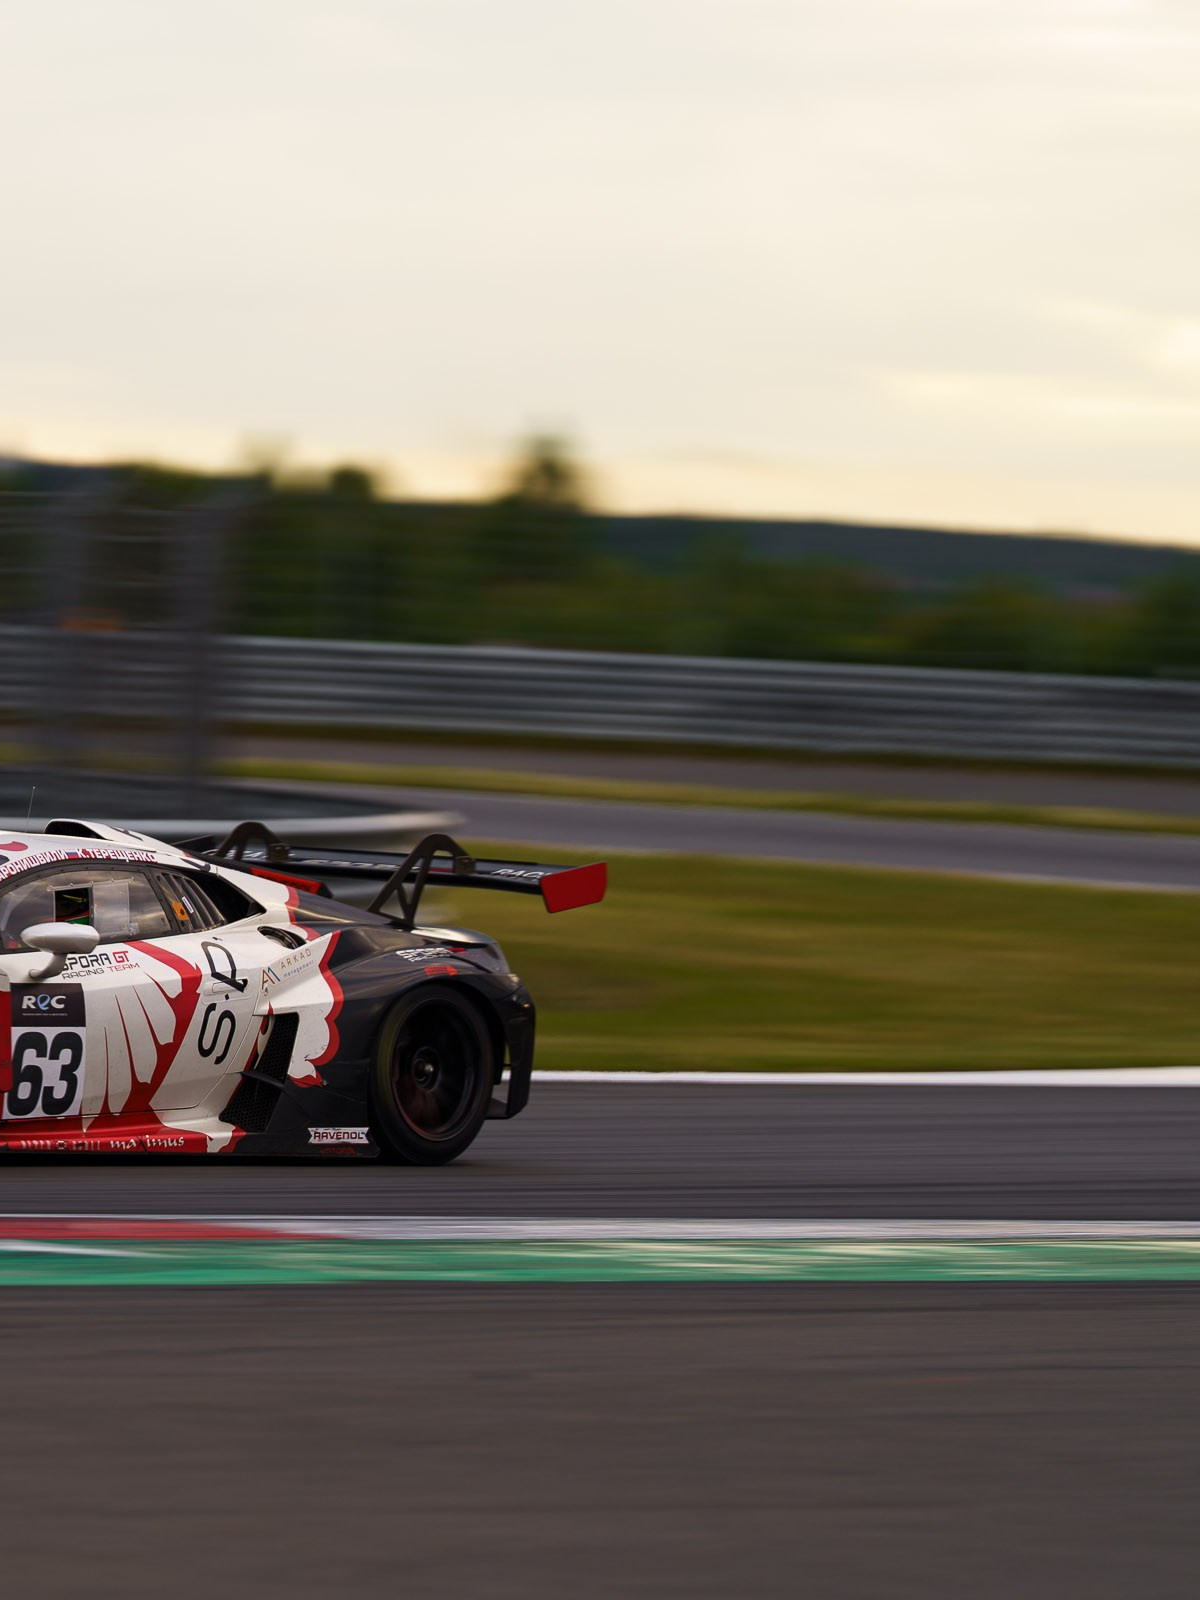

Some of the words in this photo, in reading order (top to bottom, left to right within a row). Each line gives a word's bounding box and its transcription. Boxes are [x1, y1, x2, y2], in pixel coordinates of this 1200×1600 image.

[112, 951, 130, 963] GT
[281, 948, 312, 969] ARKAD
[61, 968, 105, 980] RACING
[106, 962, 140, 973] TEAM
[6, 1031, 84, 1117] 63
[313, 1131, 365, 1140] RAVENOL
